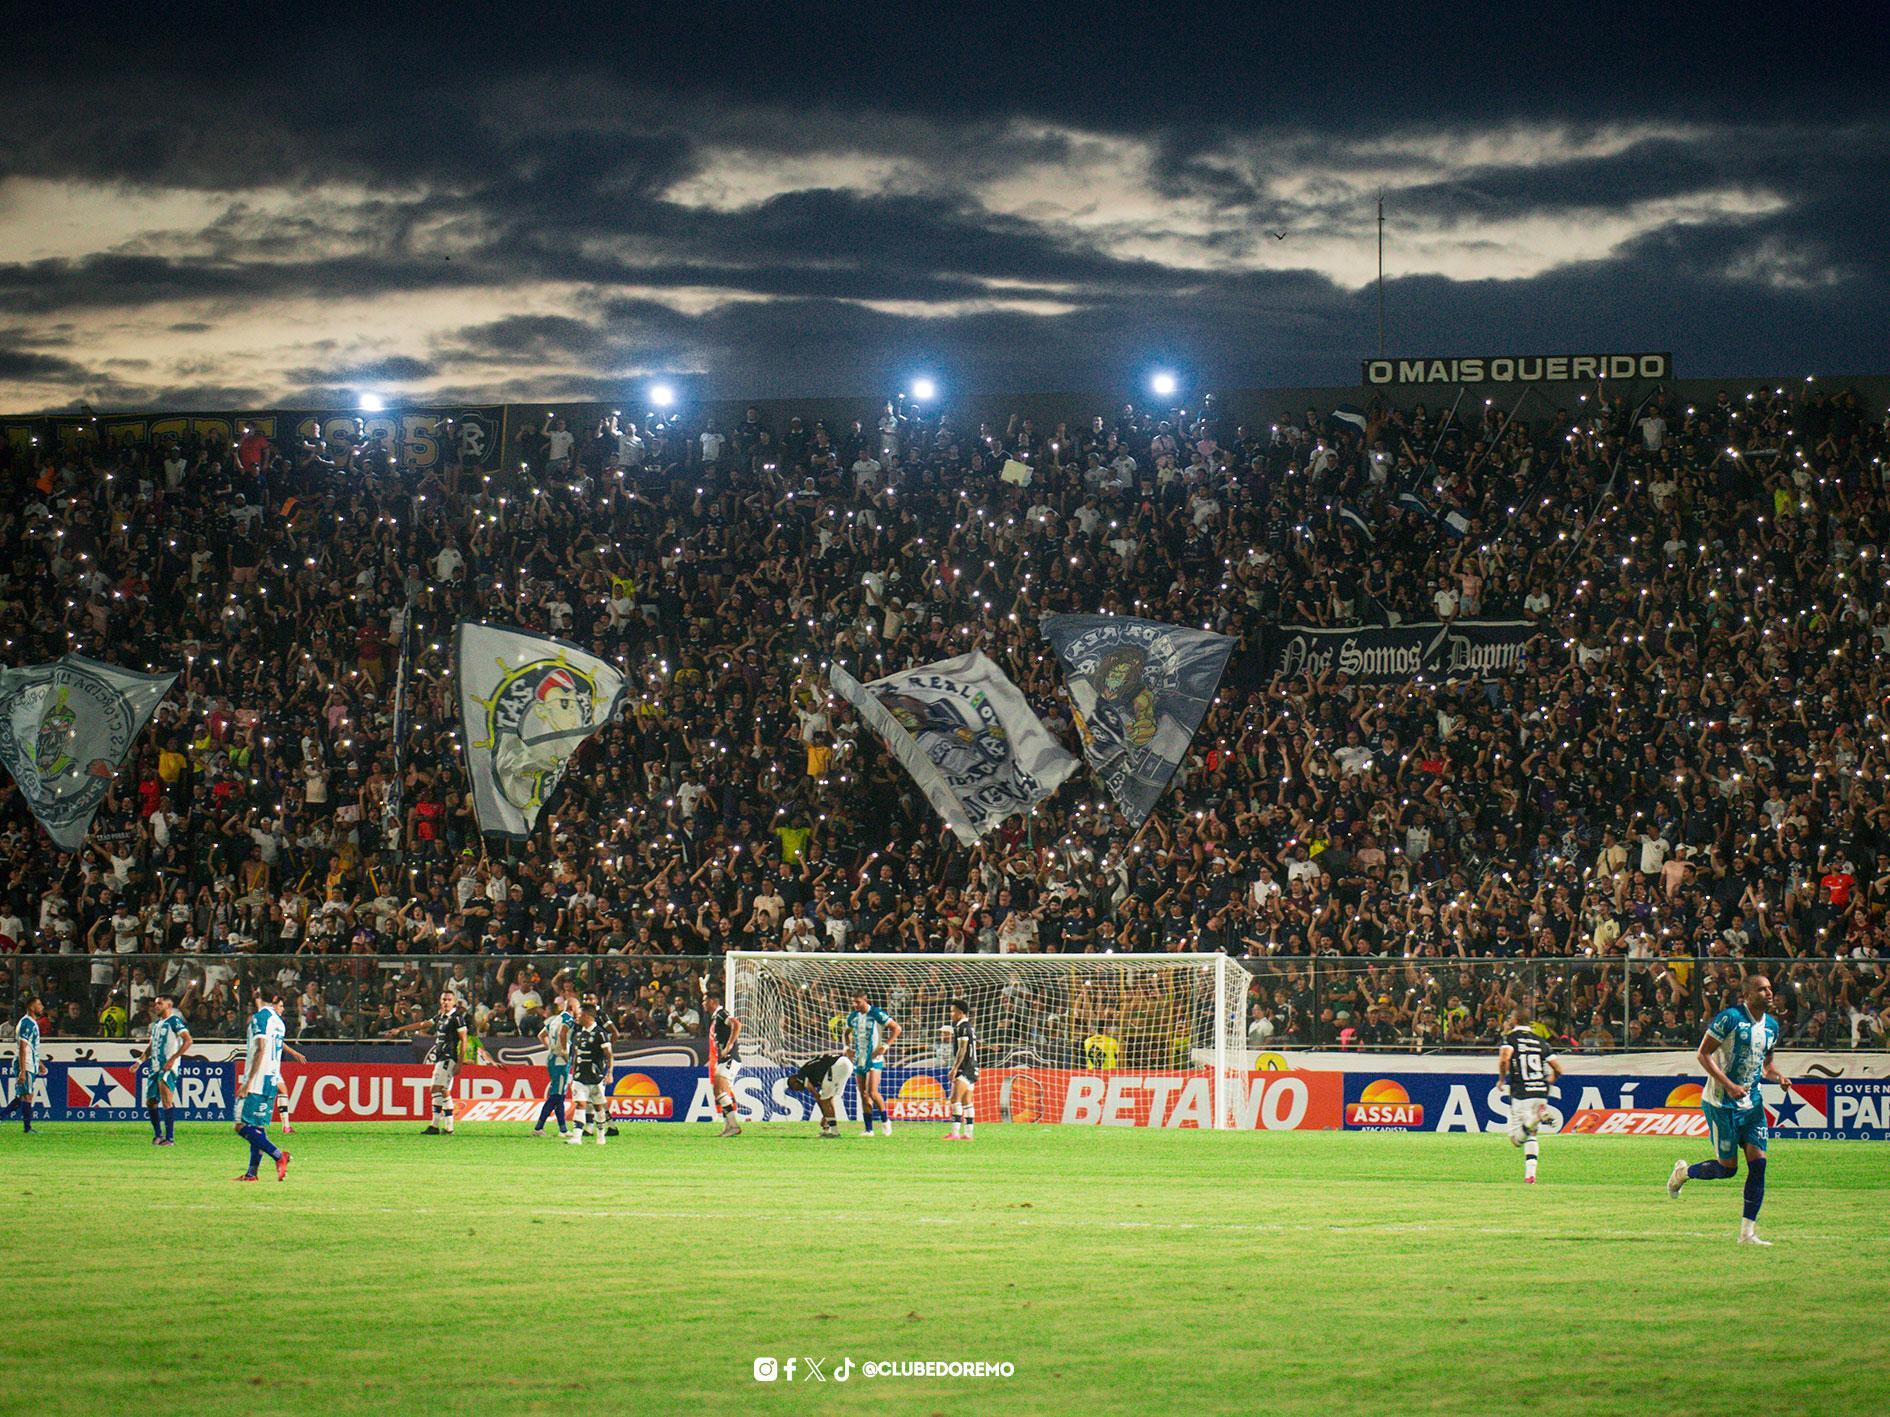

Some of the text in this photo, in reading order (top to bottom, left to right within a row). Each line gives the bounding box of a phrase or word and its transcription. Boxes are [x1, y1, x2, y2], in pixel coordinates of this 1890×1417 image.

[1368, 355, 1666, 384] O MAIS QUERIDO
[1338, 637, 1422, 675] Somos
[908, 676, 971, 699] REAL
[206, 1067, 223, 1076] DO
[1519, 1053, 1544, 1080] 19
[66, 1110, 96, 1120] POR
[184, 1108, 225, 1120] PARÁ
[1796, 1131, 1871, 1141] TODO O
